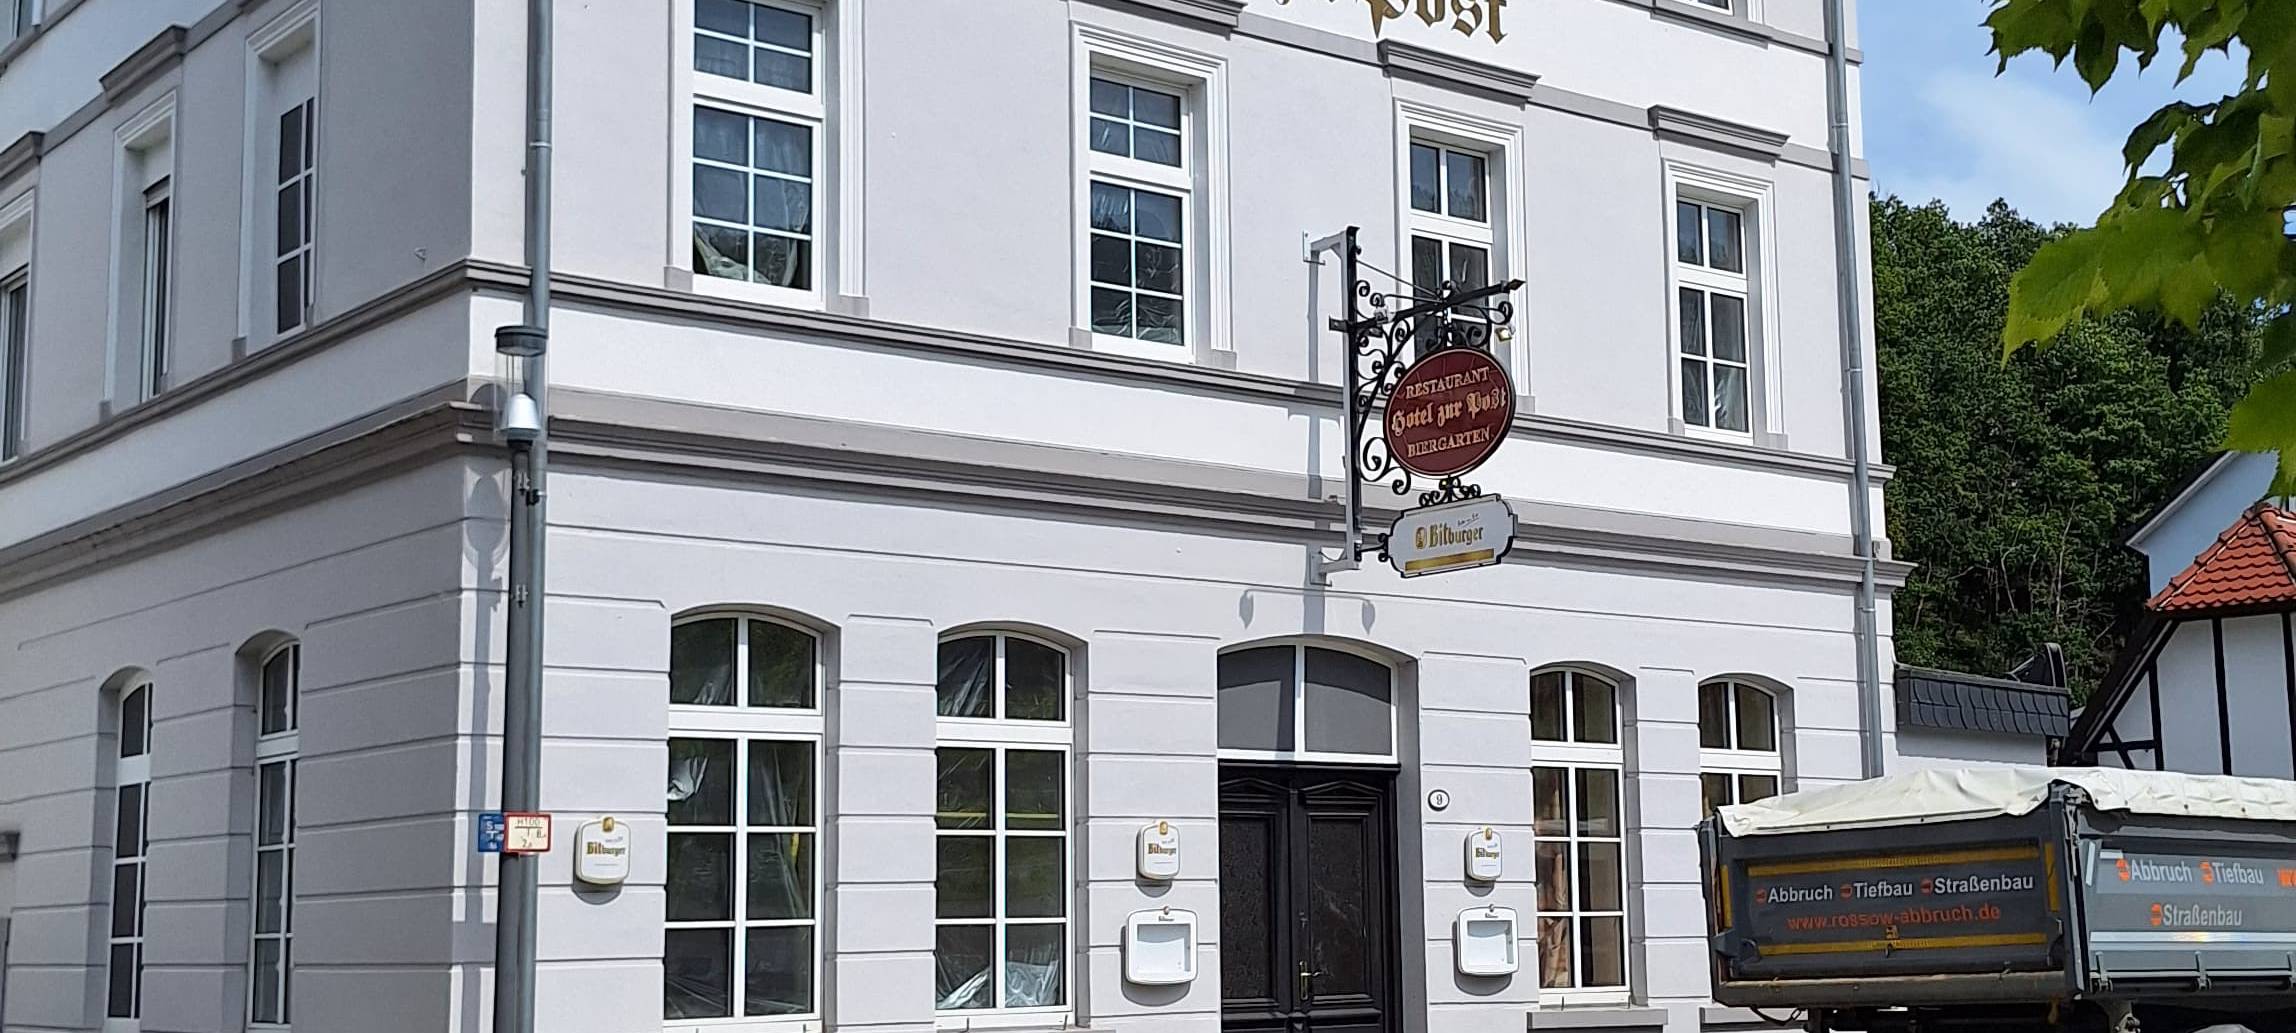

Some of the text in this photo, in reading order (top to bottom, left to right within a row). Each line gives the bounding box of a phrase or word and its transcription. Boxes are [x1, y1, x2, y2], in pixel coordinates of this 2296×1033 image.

[1406, 366, 1490, 399] RESTAURANT
[1391, 402, 1433, 437] Hotel
[1437, 400, 1463, 427] zur
[1407, 426, 1491, 457] BIERGARTEN
[1429, 523, 1484, 548] Bitburger
[1436, 794, 1443, 806] 9
[2131, 859, 2193, 882] Abbruch
[2212, 862, 2264, 885] Tiefbau
[1768, 875, 2034, 903] Abbruch Tiefbau Straßenbau
[1787, 902, 2001, 930] www.rossow-abbruch.de
[2162, 903, 2243, 927] Straßenbau
